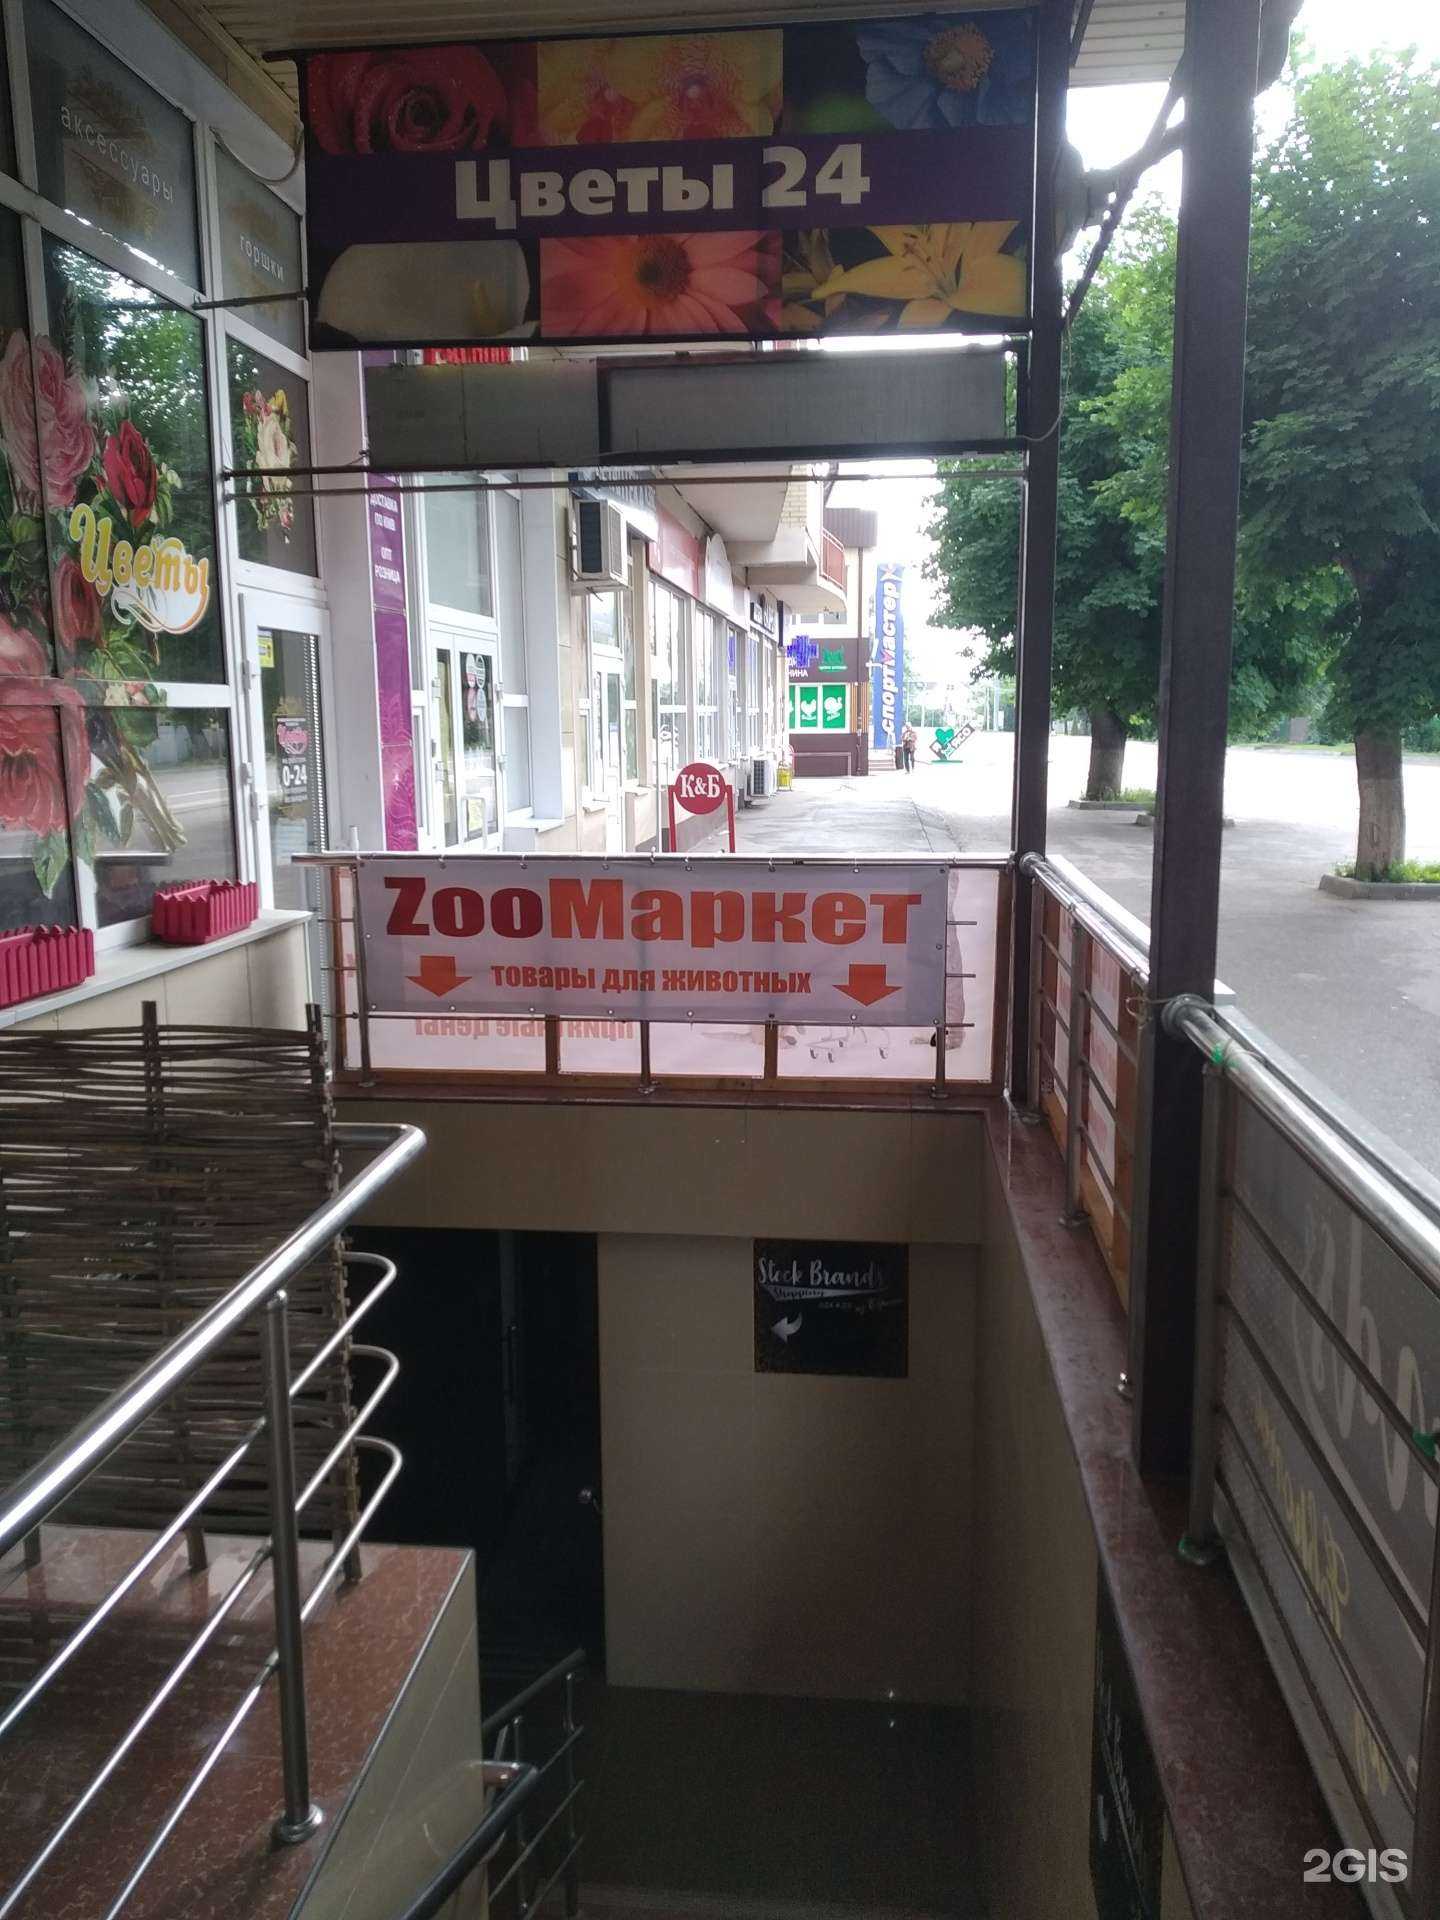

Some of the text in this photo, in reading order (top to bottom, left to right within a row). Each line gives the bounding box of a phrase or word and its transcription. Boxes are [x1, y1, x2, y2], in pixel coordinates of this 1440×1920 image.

[61, 103, 175, 204] аксессуары
[455, 142, 871, 230] Цветы 24
[239, 234, 285, 284] горшки
[69, 502, 209, 596] Цветы
[680, 774, 721, 799] К&Б
[384, 877, 922, 948] ZooМаркет
[490, 965, 813, 994] товары для животных
